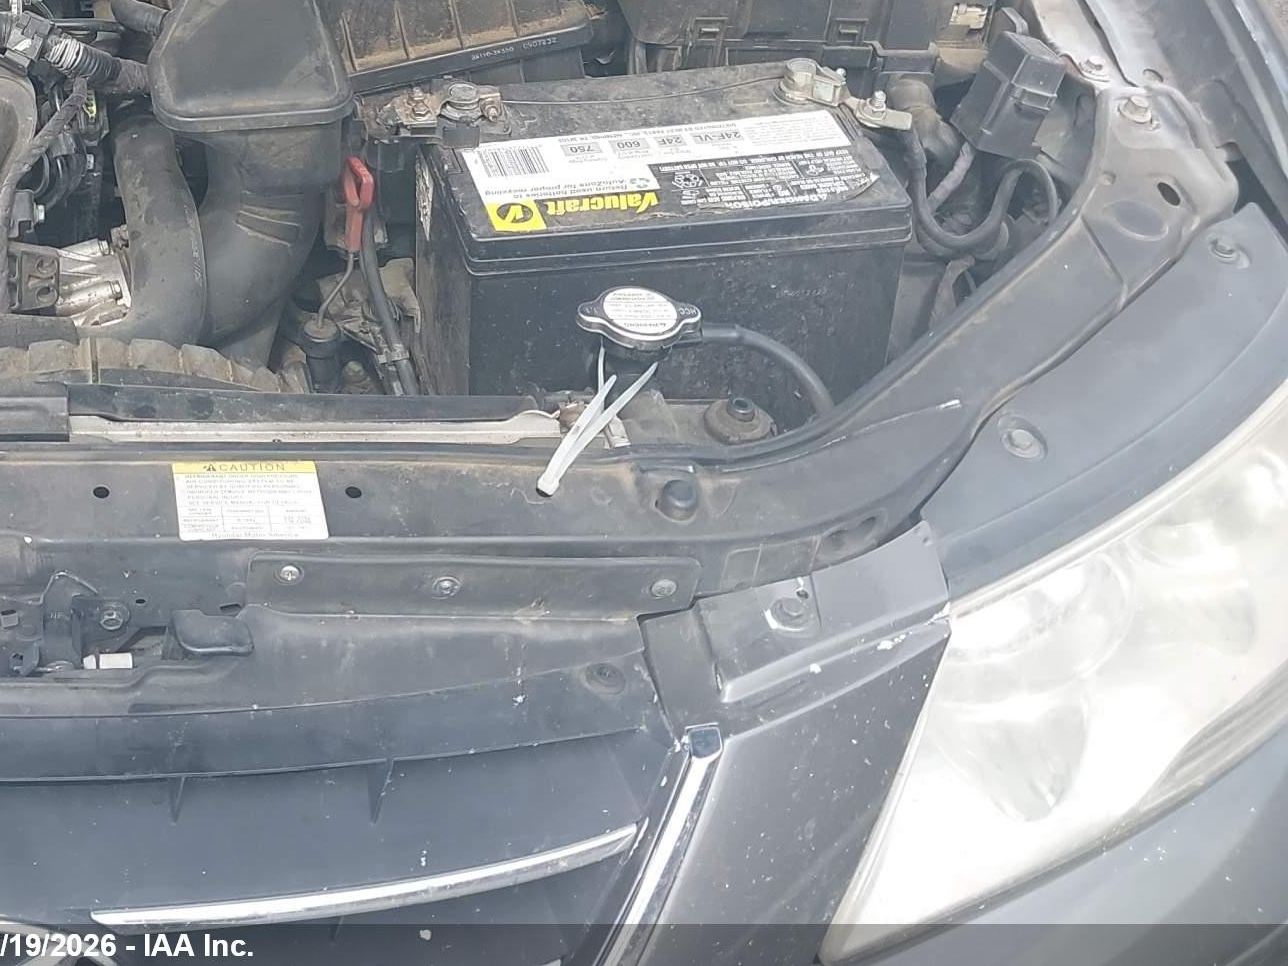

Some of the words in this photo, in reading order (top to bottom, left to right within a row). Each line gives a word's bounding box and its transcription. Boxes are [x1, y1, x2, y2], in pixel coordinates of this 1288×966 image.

[657, 136, 682, 145] 24F
[692, 131, 740, 142] 24F-VL
[569, 144, 593, 153] 750
[616, 140, 640, 149] 600
[579, 178, 624, 187] AutoZone
[484, 186, 527, 196] recycling
[529, 183, 560, 192] proper
[594, 184, 627, 192] Return
[525, 189, 566, 198] batteries
[545, 191, 659, 216] Valucraft
[219, 463, 286, 472] CAUTION
